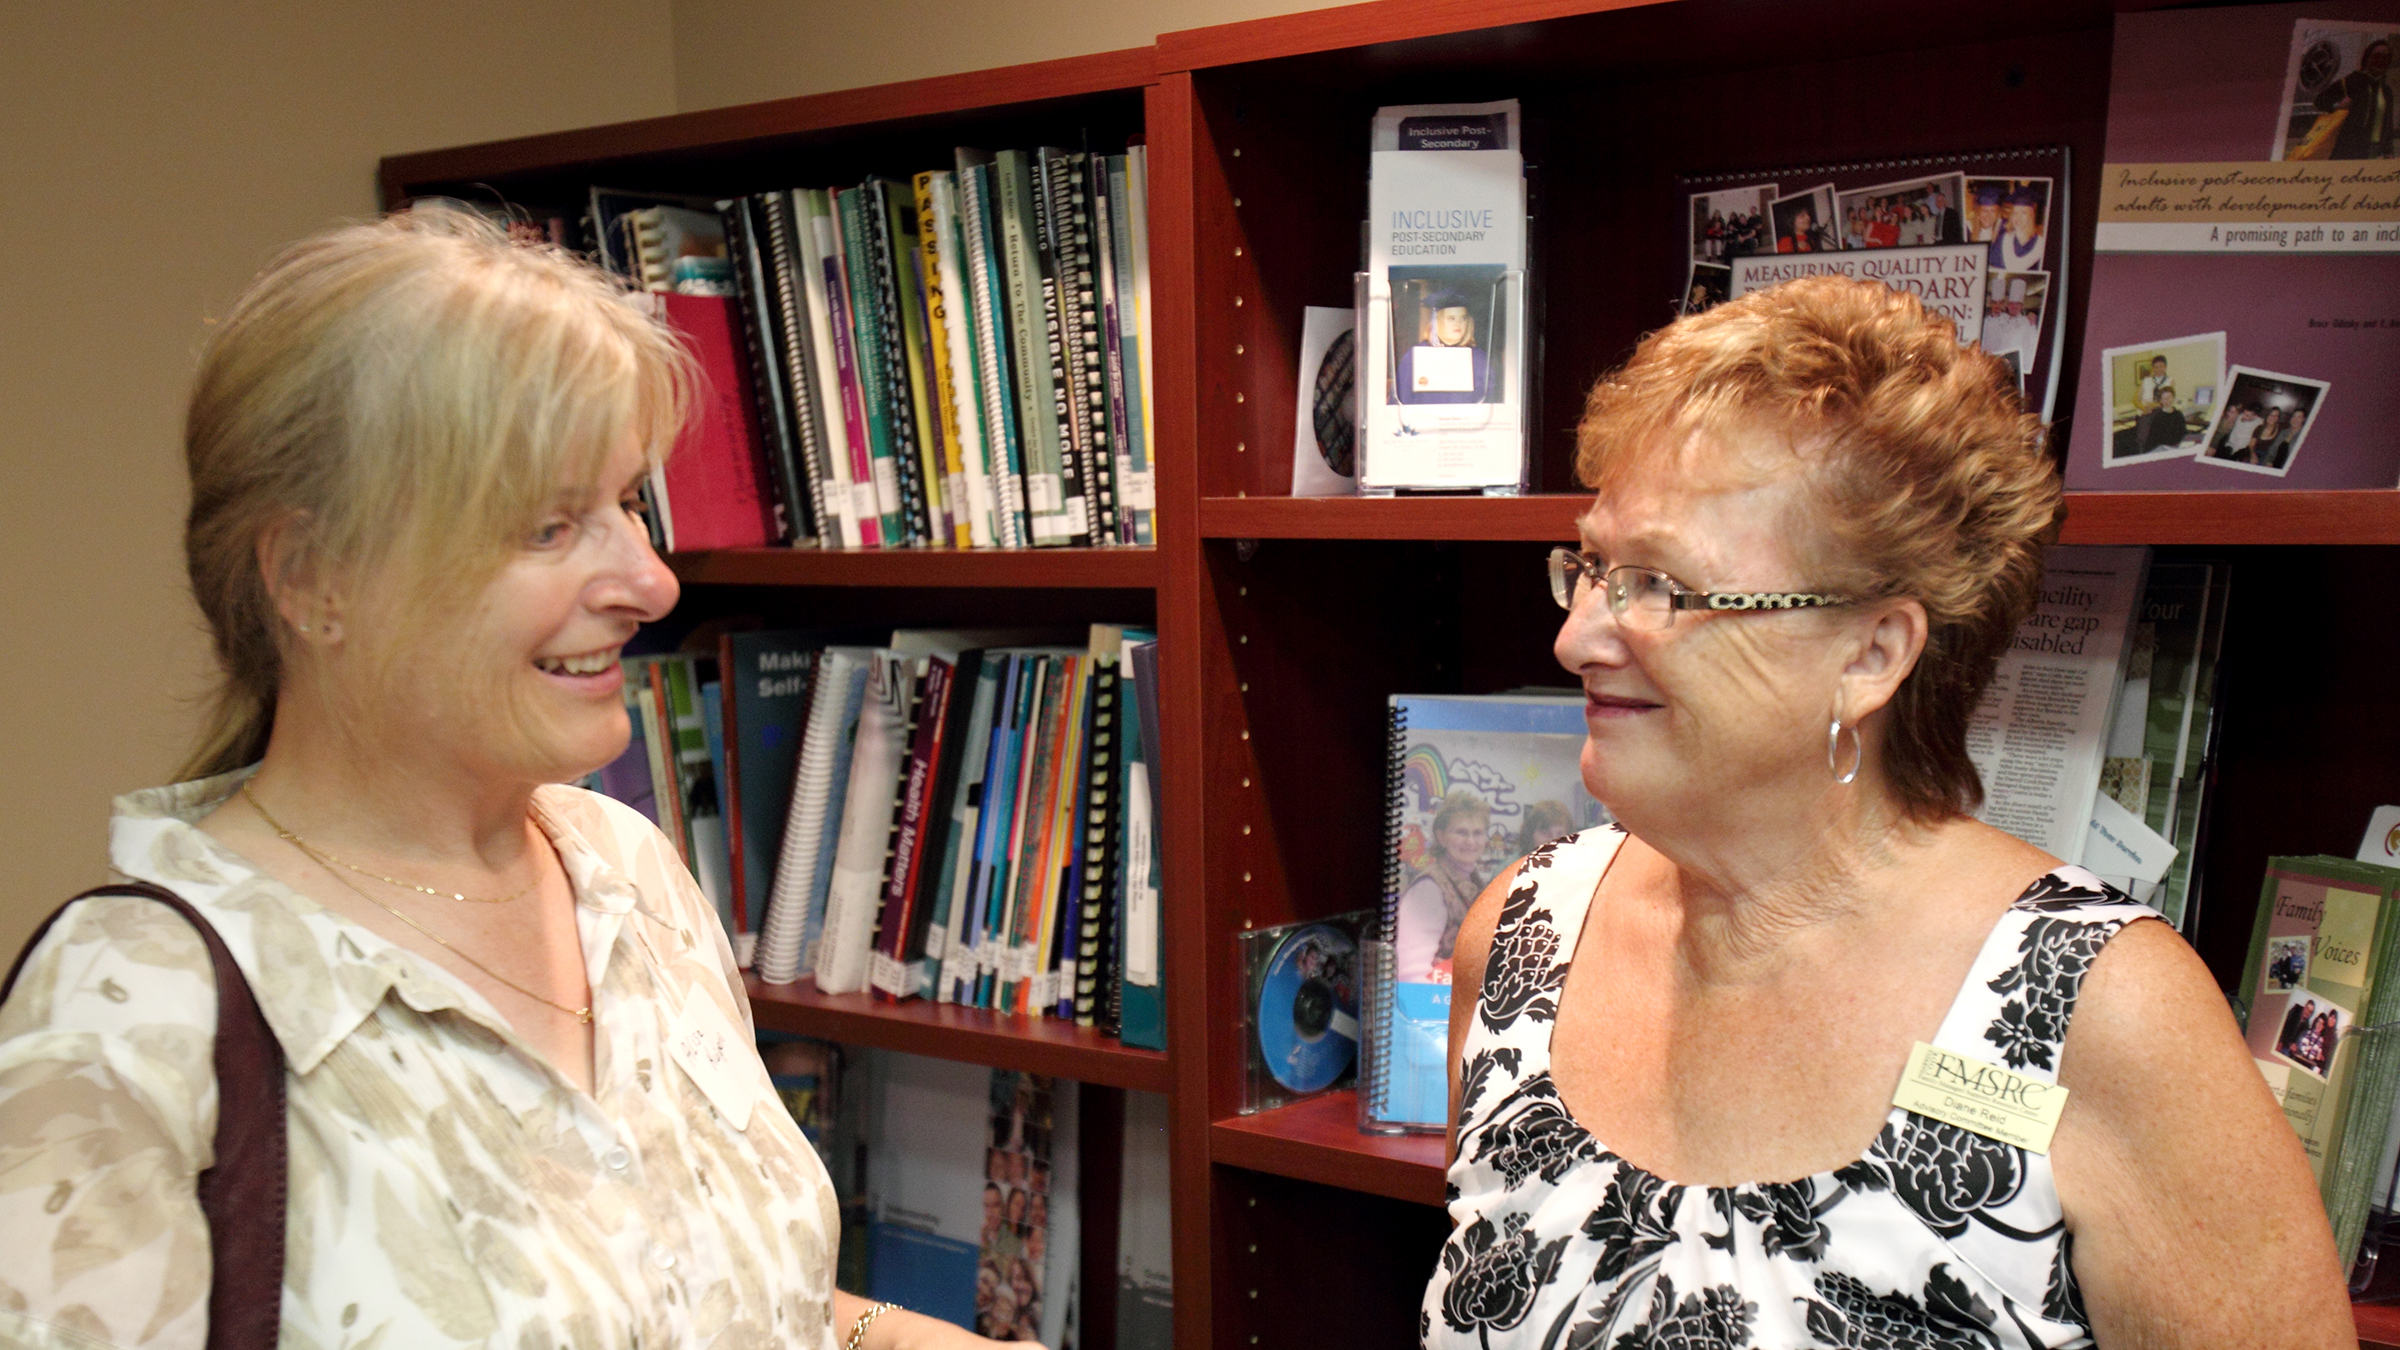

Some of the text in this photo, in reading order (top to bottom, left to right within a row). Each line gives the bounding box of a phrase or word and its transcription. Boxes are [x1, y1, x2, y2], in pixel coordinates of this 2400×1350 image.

[1409, 125, 1492, 137] Inclusive Post-
[1420, 138, 1479, 149] Secondary
[2119, 167, 2400, 195] Inclusive post-secondary educat
[1031, 164, 1047, 251] PIETROPAOLO
[2114, 193, 2400, 218] adults with developmental disab
[1393, 209, 1493, 230] INCLUSIVE
[919, 175, 947, 319] PASSING
[1392, 231, 1486, 243] POST-SECONDARY
[2210, 225, 2400, 247] A promising path to an incl
[1392, 244, 1457, 256] EDUCATION
[1744, 255, 1977, 282] MEASURING QUALITY IN
[1008, 233, 1032, 402] Return To The Community
[1043, 277, 1074, 480] INVISIBLE NO MORE
[2038, 585, 2098, 611] acility
[2021, 610, 2099, 636] are gap
[2012, 630, 2085, 655] isabled
[759, 651, 811, 672] Maki
[906, 758, 928, 824] Health
[891, 827, 917, 897] Matters
[2276, 895, 2326, 930] Family
[2312, 935, 2360, 965] Voices
[1913, 1100, 2030, 1144] Advisory Committee Member
[1944, 1096, 2007, 1125] Diane Reid
